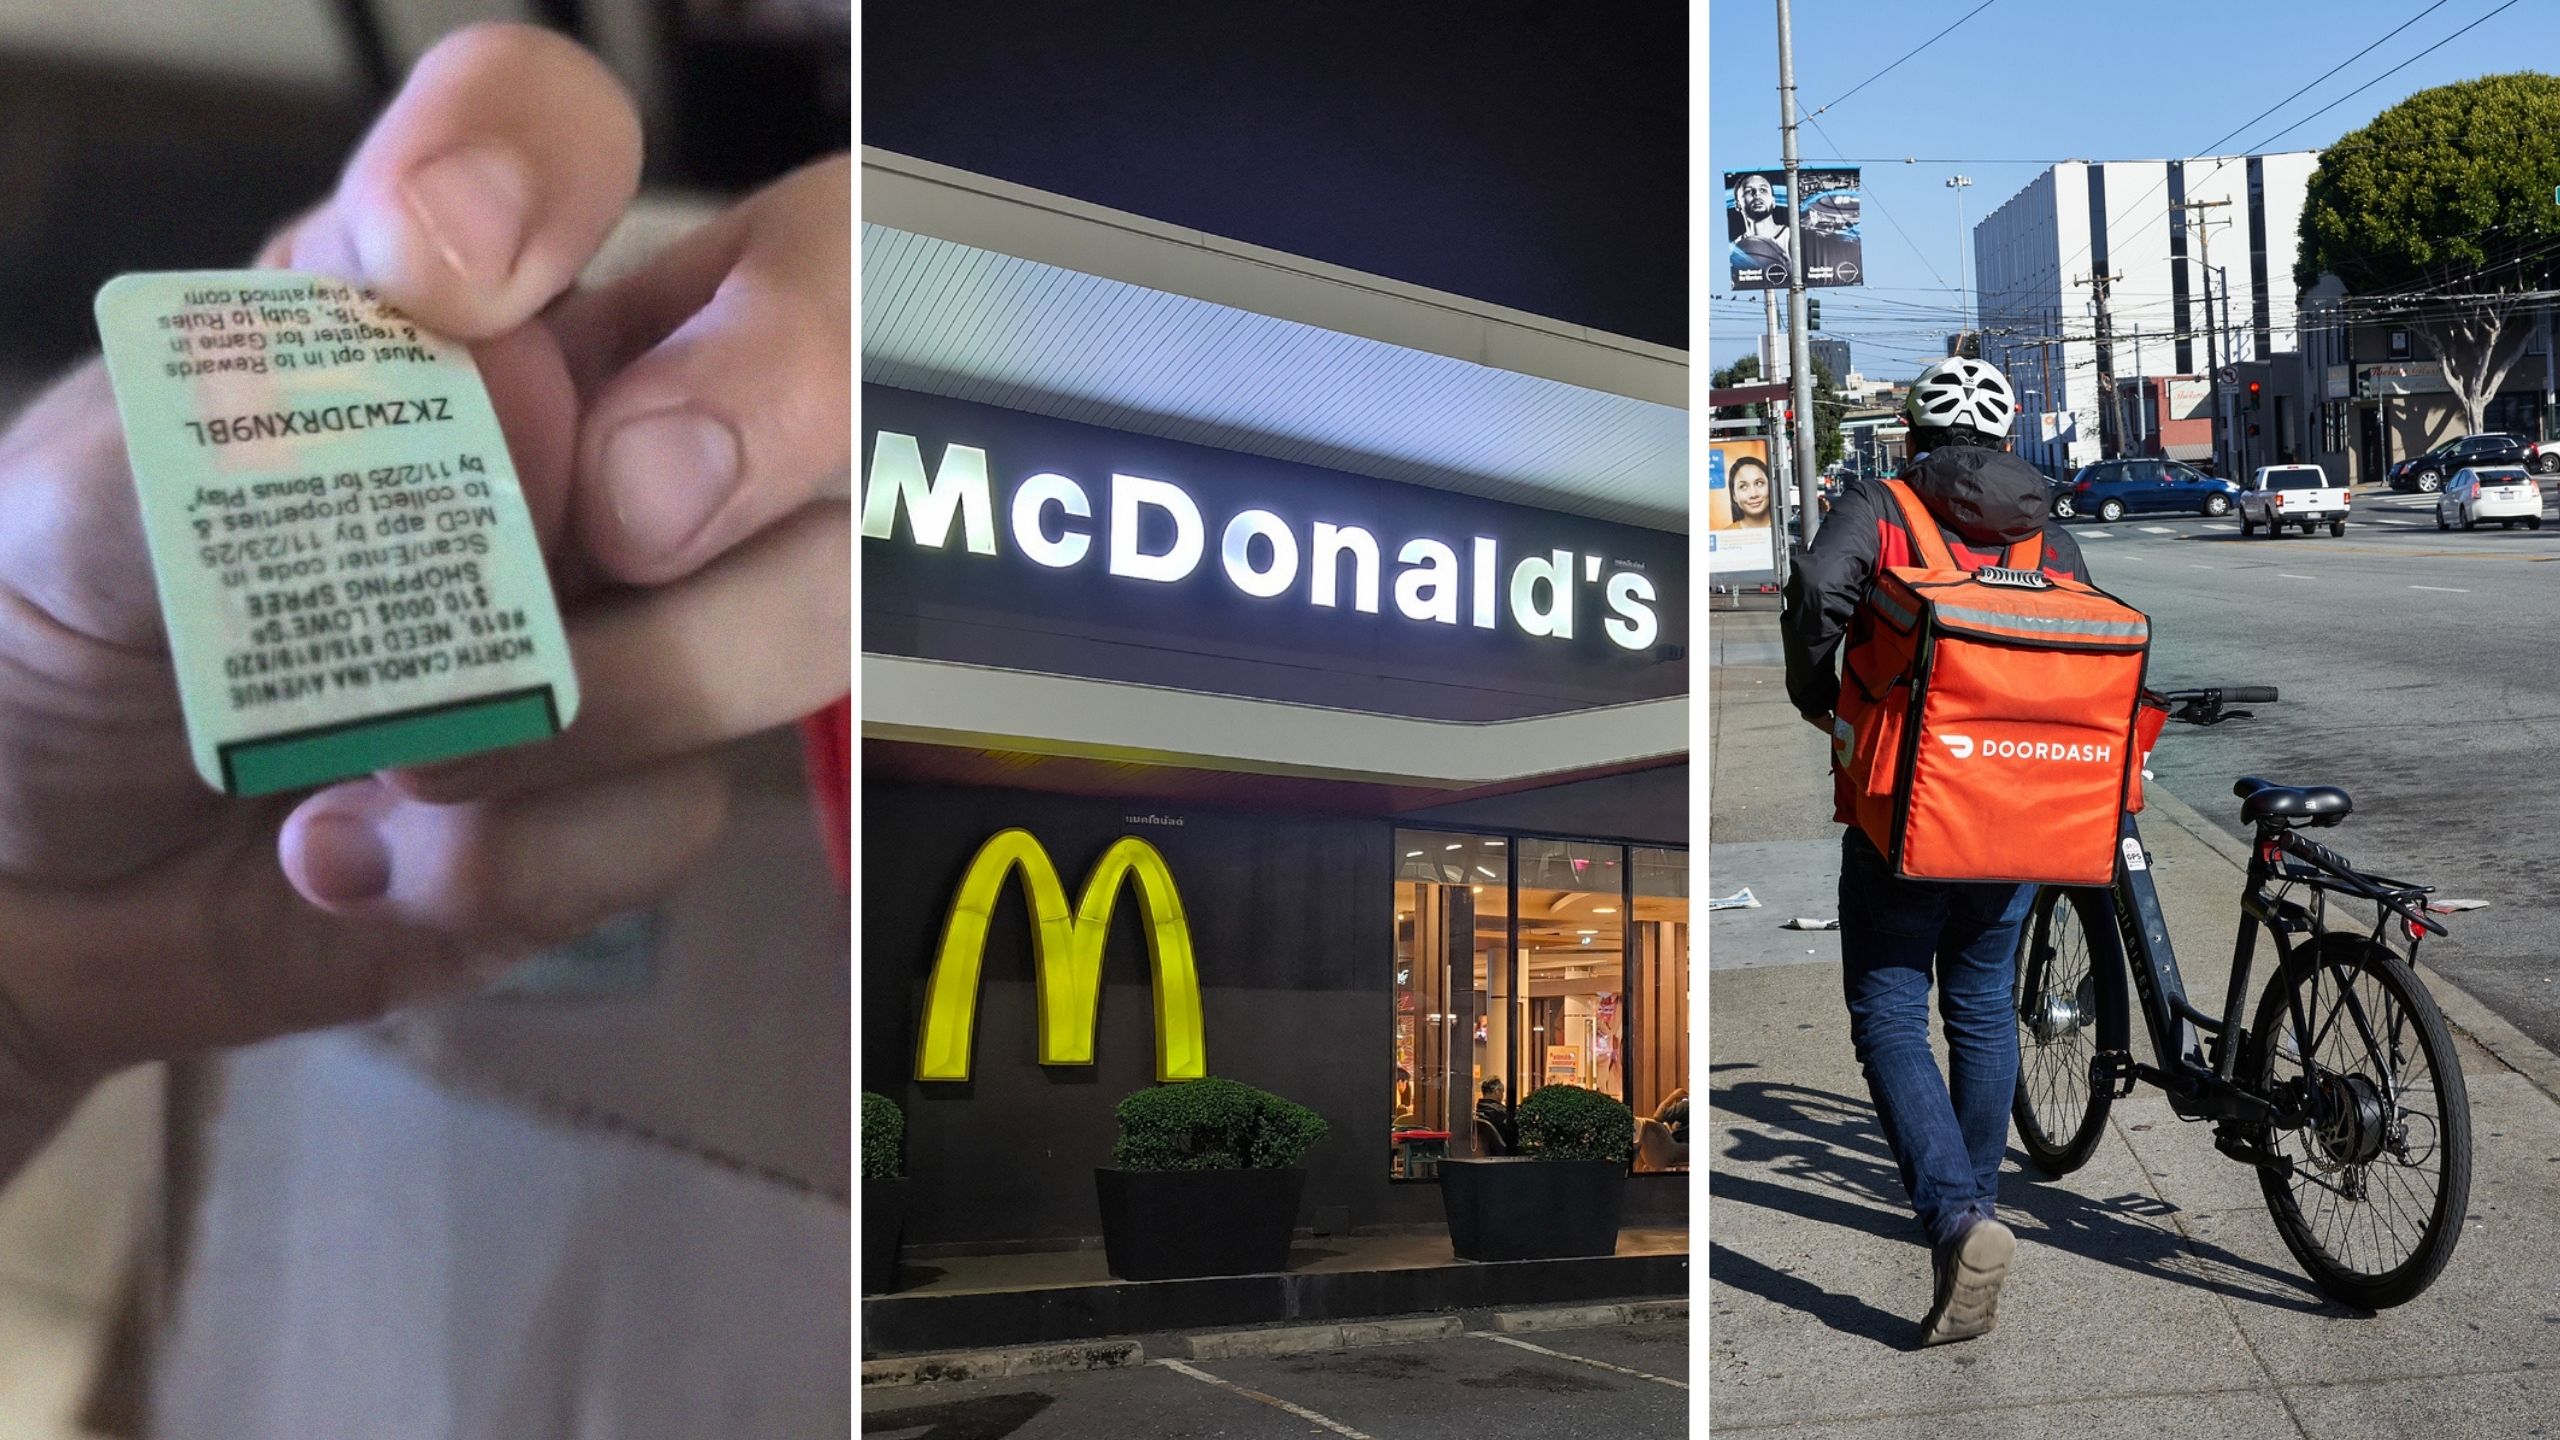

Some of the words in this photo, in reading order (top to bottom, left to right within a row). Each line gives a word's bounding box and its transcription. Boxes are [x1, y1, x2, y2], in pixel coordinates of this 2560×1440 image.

[184, 283, 350, 306] playatmcd.com
[157, 313, 225, 331] Rules
[232, 309, 255, 326] to
[260, 305, 310, 328] Subj
[199, 332, 267, 351] Game
[276, 330, 305, 348] for
[314, 323, 395, 344] register
[169, 337, 193, 356] in
[331, 345, 365, 366] opt
[165, 356, 269, 378] Rewards
[275, 353, 297, 370] to
[303, 351, 327, 369] in
[184, 398, 454, 446] ZKZWJDRXN9BL
[367, 460, 452, 490] 11/2/25
[458, 453, 486, 475] by
[251, 475, 327, 498] Bonus
[331, 471, 364, 492] for
[464, 480, 490, 498] to
[368, 486, 455, 512] collect
[222, 492, 360, 531] properties
[435, 506, 498, 533] McD
[192, 518, 213, 540] &
[335, 520, 367, 544] by
[375, 512, 426, 537] app
[200, 529, 323, 568] 11/23/25
[337, 533, 490, 571] Scan/Enter
[861, 430, 1659, 653] McDonald's
[220, 568, 248, 589] in
[257, 556, 327, 583] code
[343, 560, 482, 602] SHOPPING
[245, 582, 338, 619] SPREE
[383, 620, 453, 653] NEED
[455, 634, 535, 670] NORTH
[330, 650, 450, 690] CAROLINA
[230, 673, 326, 711] AVENUE
[1982, 739, 2111, 763] DOORDASH
[2127, 937, 2150, 999] BIKES
